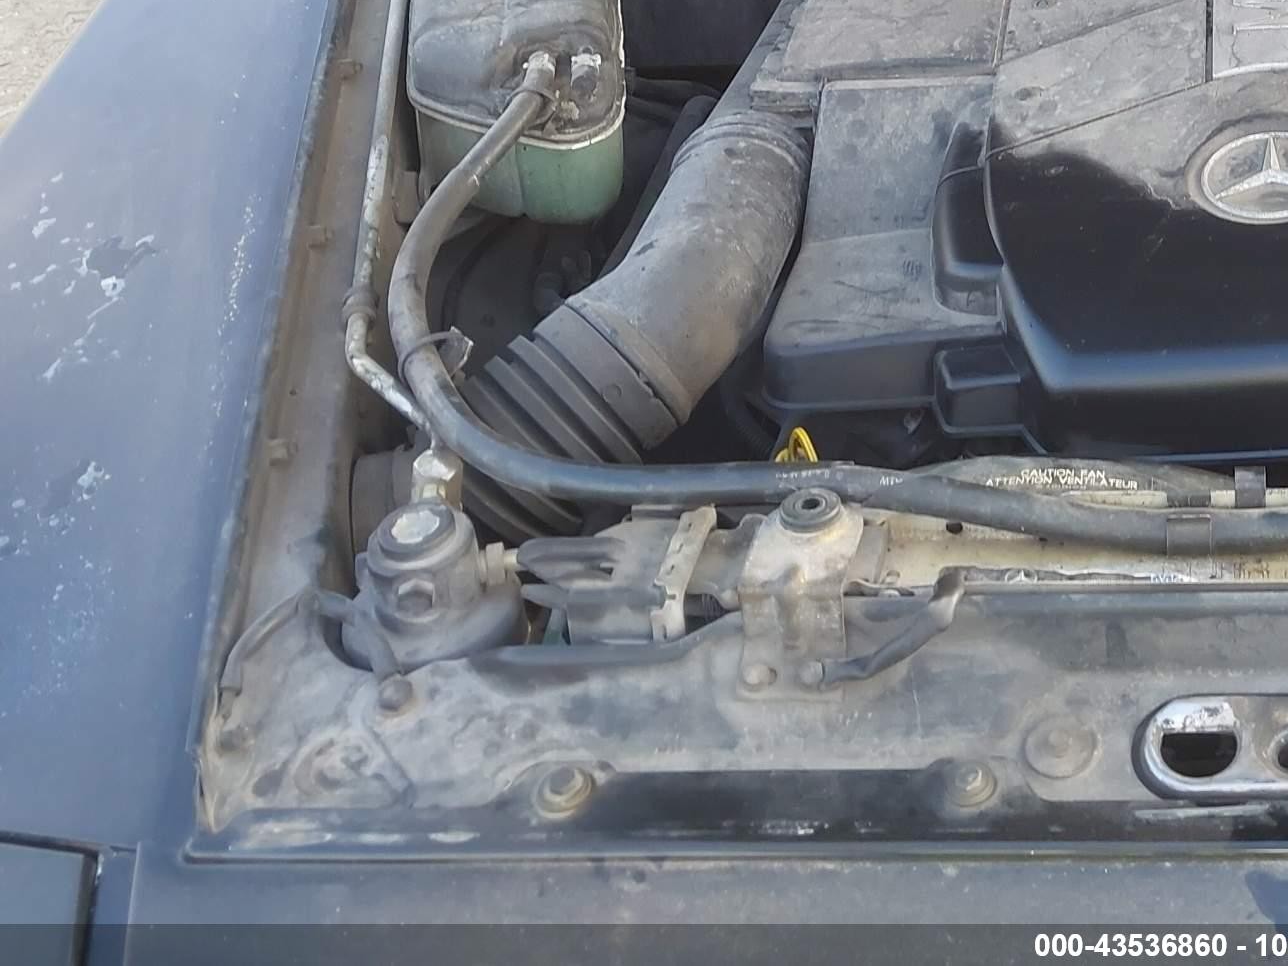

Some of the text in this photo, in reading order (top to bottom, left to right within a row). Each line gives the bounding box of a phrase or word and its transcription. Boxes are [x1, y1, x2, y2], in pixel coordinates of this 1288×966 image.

[1021, 468, 1075, 478] CAUTION
[984, 475, 1054, 488] ATTENTION
[1059, 474, 1138, 490] VENTILATEUR
